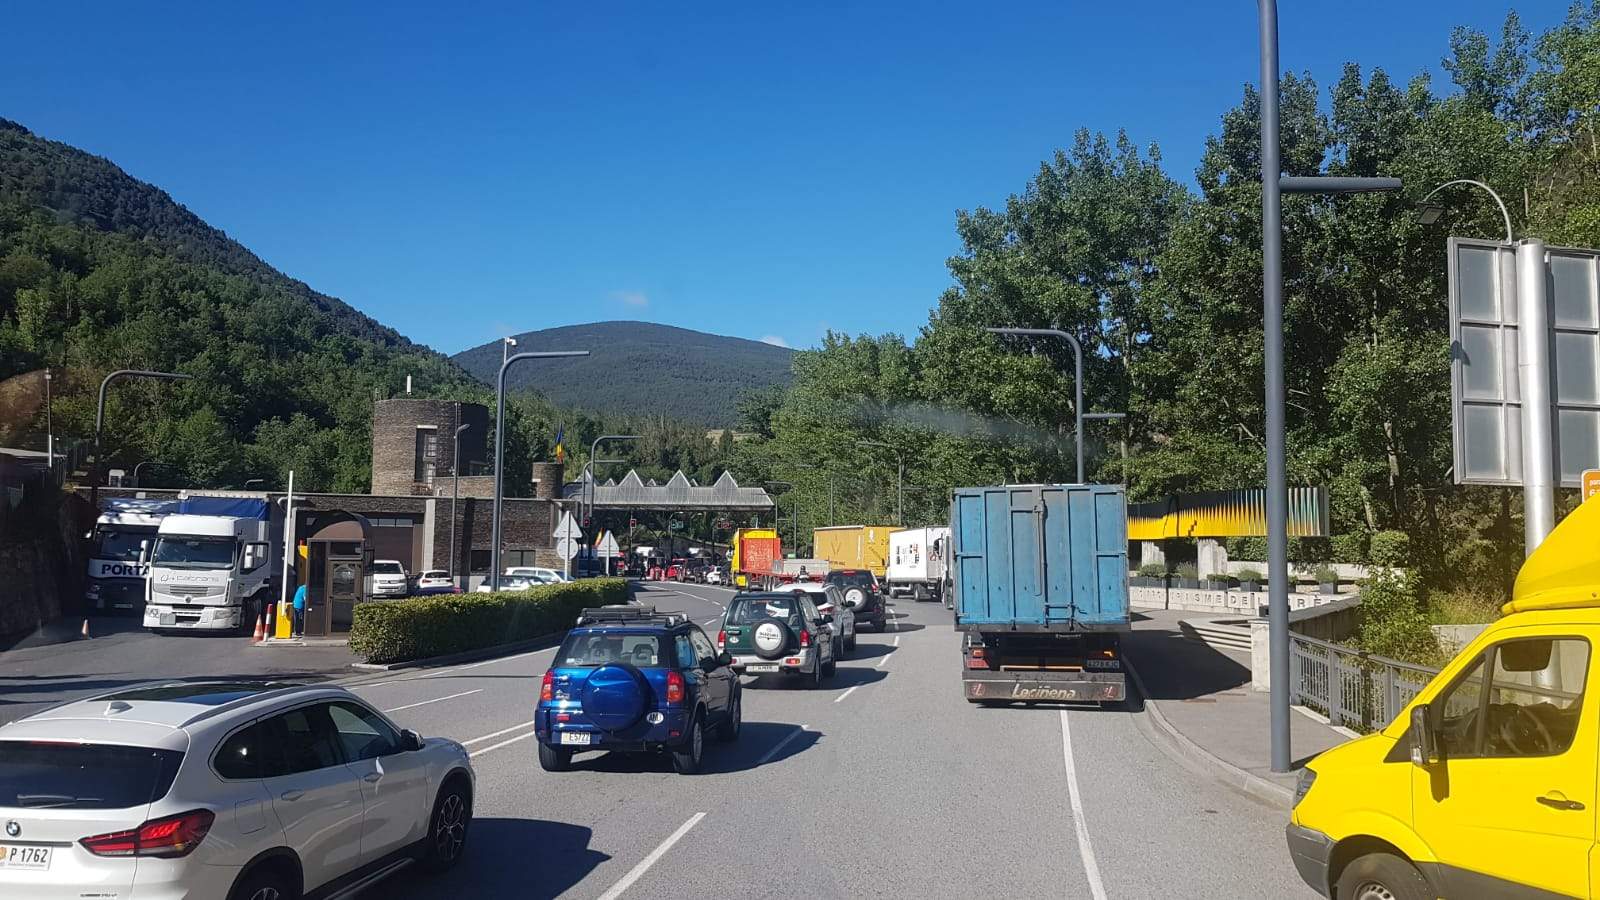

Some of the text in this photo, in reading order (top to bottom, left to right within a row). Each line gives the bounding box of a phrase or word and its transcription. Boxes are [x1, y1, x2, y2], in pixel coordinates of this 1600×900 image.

[102, 564, 150, 575] PORTA
[1012, 684, 1076, 699] Leciñena
[21, 848, 48, 863] 1762
